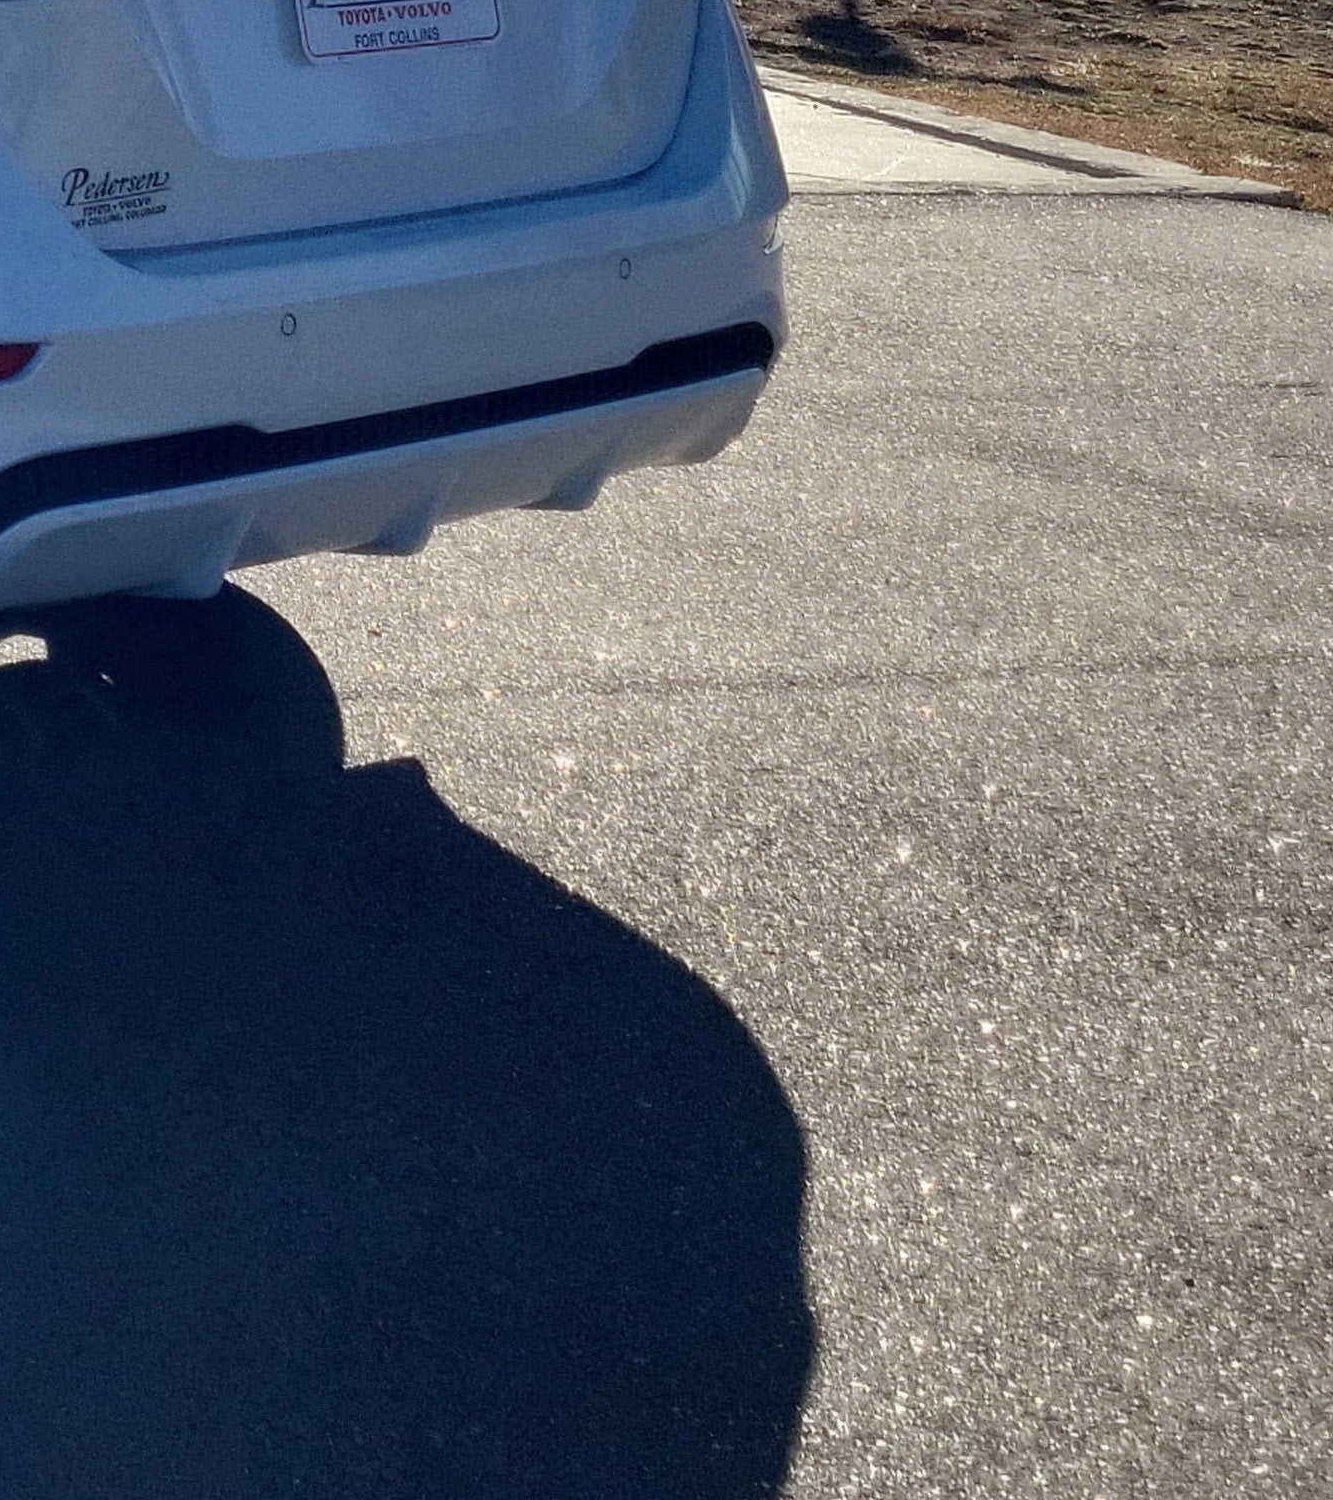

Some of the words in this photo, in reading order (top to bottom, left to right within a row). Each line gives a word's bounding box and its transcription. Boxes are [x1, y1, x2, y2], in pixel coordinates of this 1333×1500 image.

[337, 7, 386, 27] TOYOTA
[394, 1, 452, 20] VOLVO
[354, 31, 383, 49] FORT
[388, 26, 440, 45] COLLINS
[61, 167, 171, 208] Pedersen
